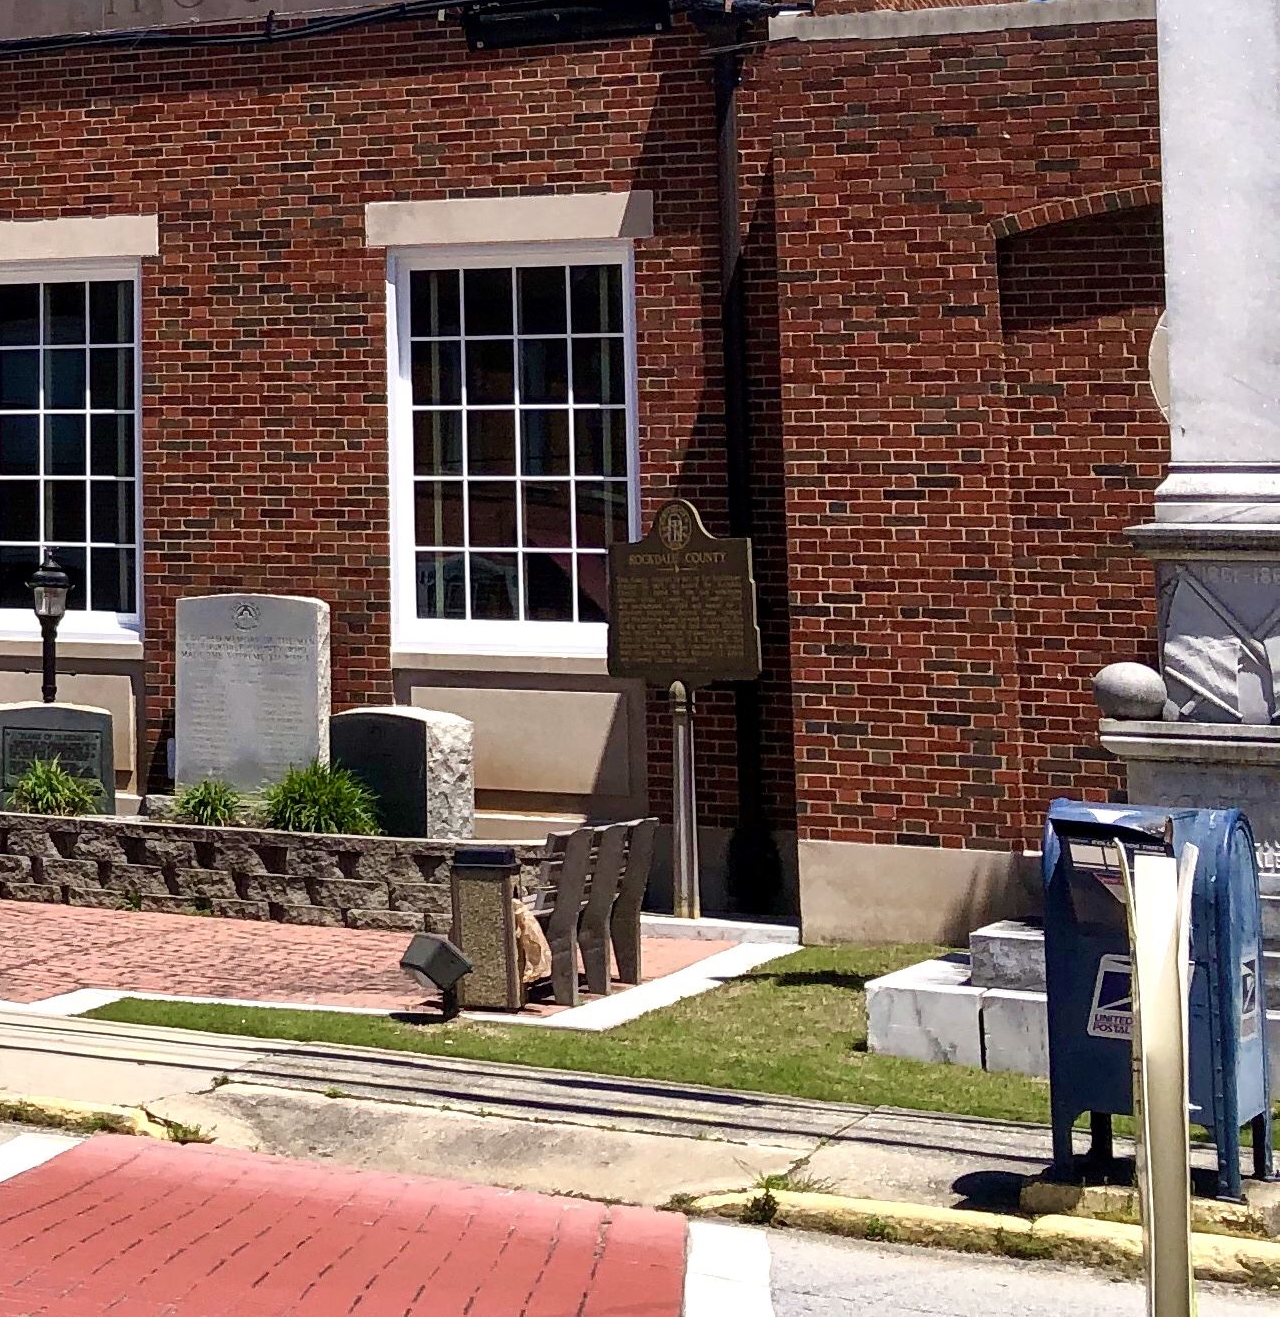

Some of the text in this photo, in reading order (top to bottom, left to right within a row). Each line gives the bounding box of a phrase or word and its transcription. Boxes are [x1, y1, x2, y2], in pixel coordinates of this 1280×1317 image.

[685, 552, 727, 563] COUNTY
[1094, 1014, 1133, 1025] UNITED
[1092, 1021, 1130, 1034] POSTAL
